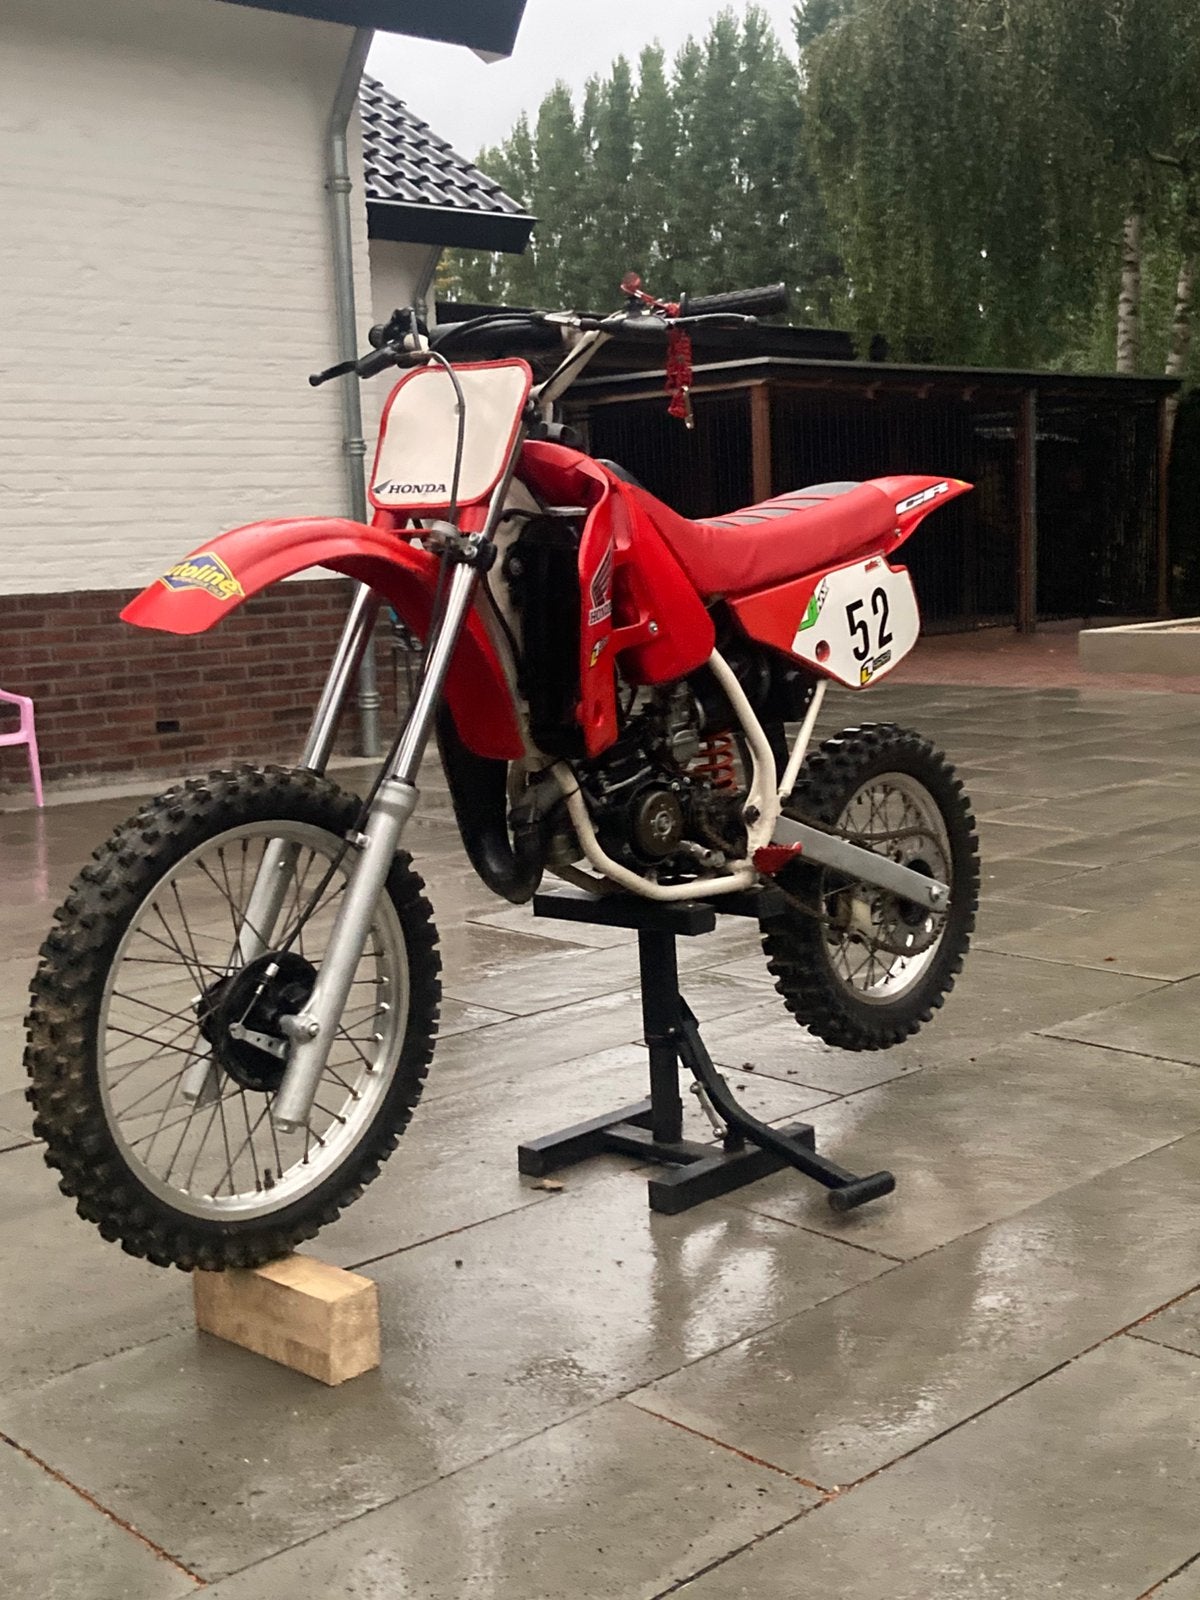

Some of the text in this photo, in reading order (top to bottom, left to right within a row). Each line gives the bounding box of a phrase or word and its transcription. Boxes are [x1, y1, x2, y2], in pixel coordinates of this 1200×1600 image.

[388, 483, 447, 494] HONDA
[896, 482, 949, 514] CR
[845, 587, 893, 661] 52
